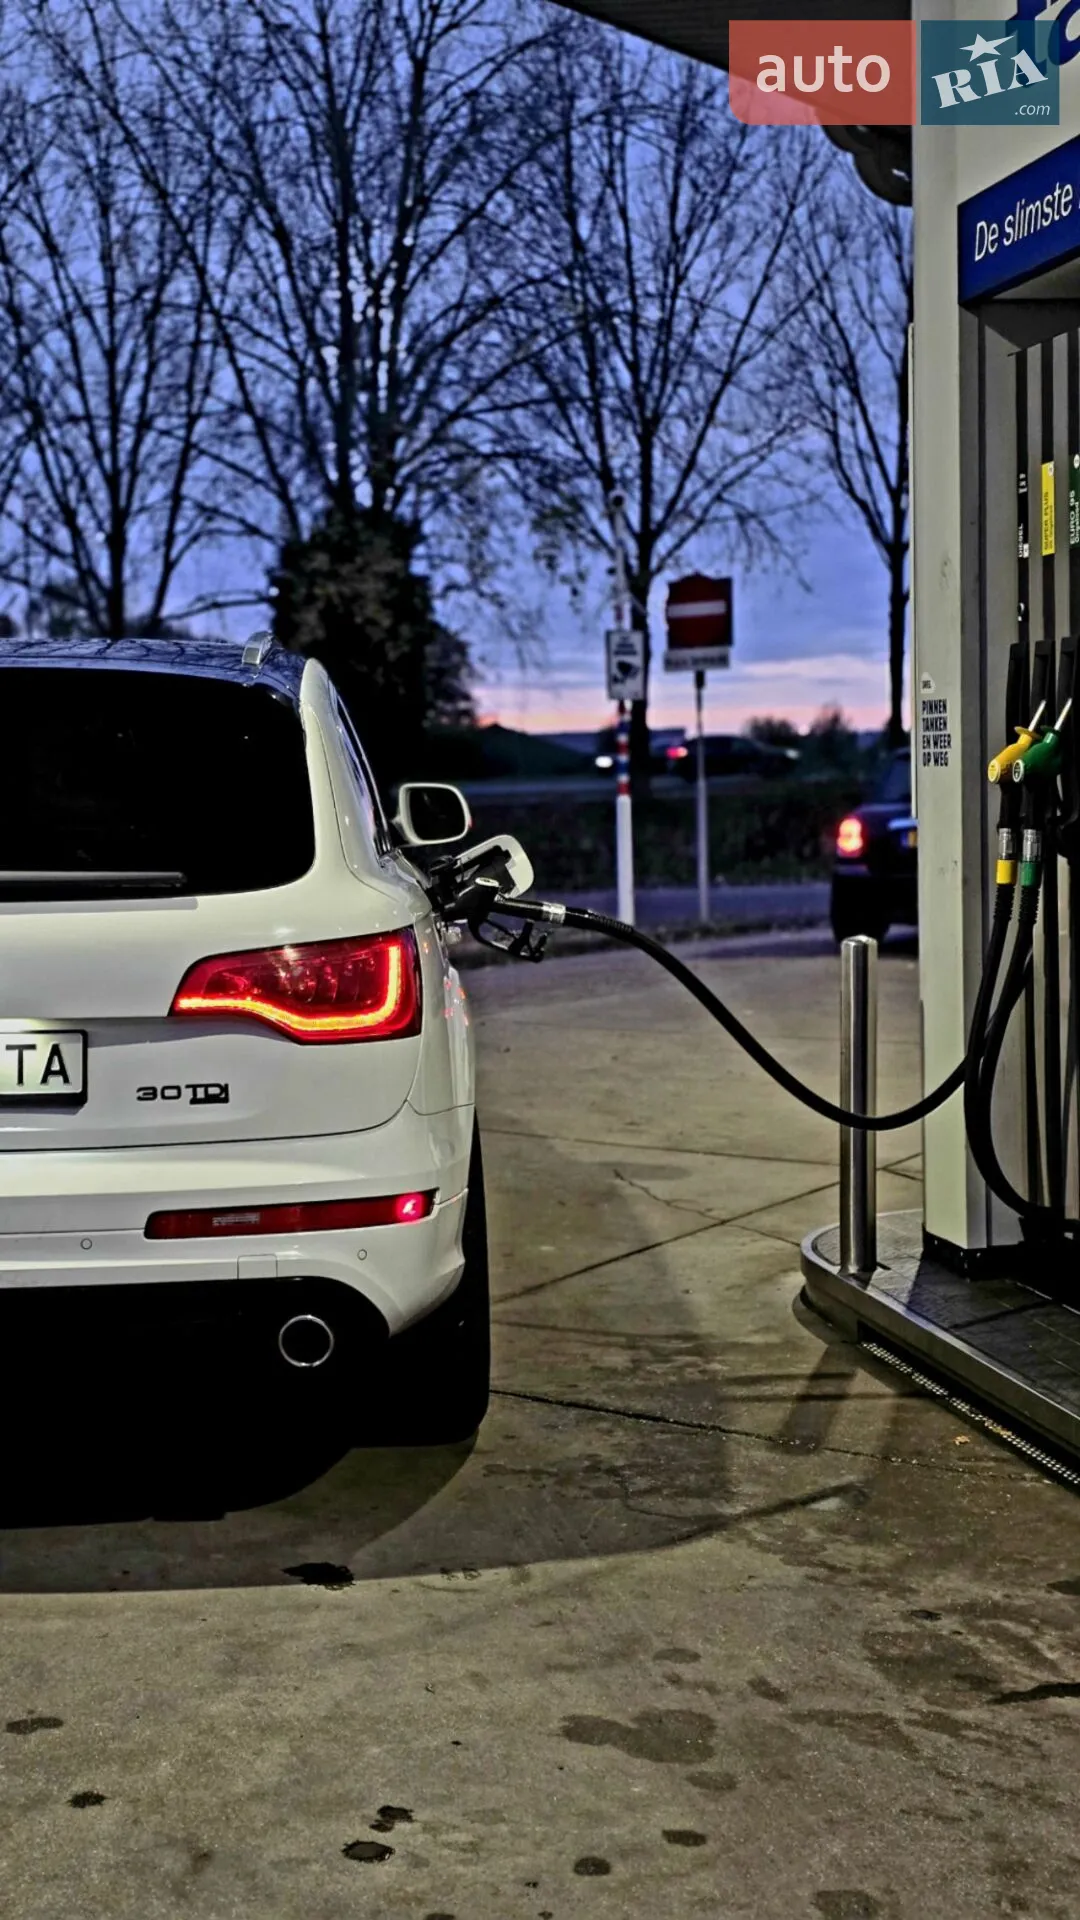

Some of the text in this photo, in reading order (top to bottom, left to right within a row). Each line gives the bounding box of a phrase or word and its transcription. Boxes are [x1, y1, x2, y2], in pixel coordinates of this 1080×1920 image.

[974, 181, 1073, 262] De slimste
[922, 699, 947, 715] PINNEN
[922, 716, 947, 732] TANKEN
[922, 733, 952, 750] EN WEER
[922, 751, 948, 767] OP WEG
